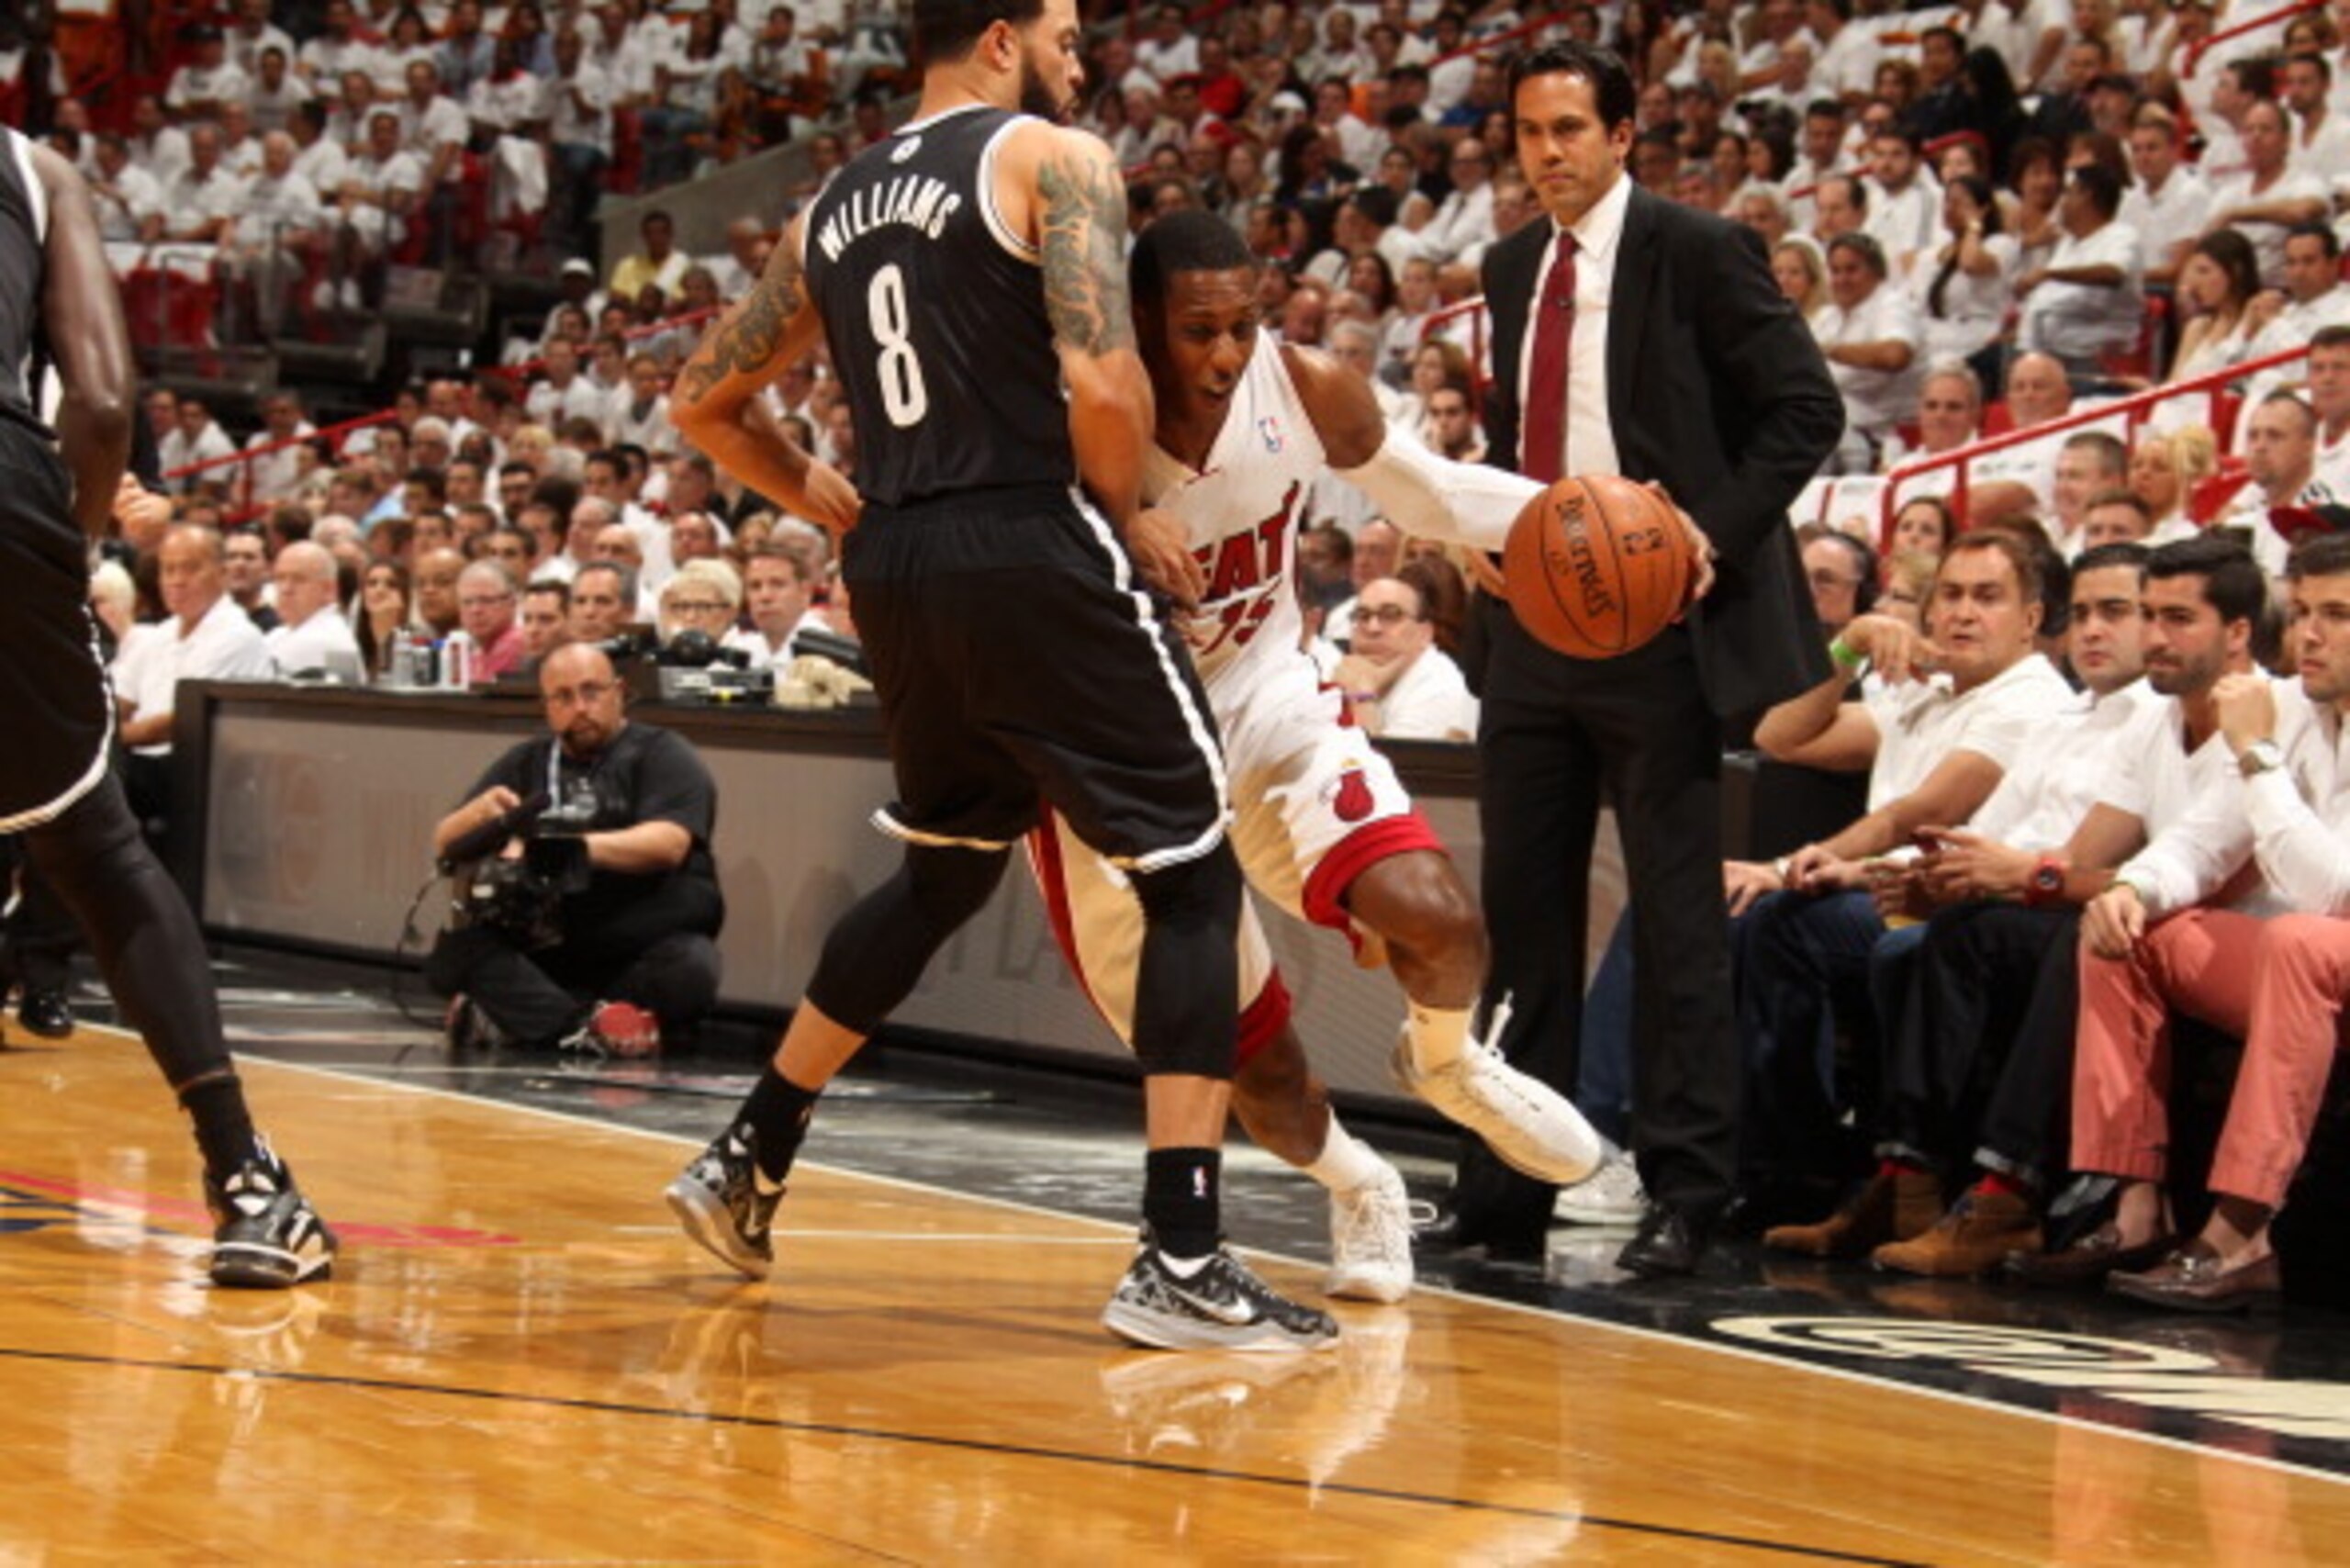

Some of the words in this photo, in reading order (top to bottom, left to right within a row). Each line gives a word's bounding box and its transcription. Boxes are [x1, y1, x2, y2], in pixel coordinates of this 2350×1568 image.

[817, 174, 961, 263] WILLIAMS
[867, 262, 928, 428] 8
[1191, 479, 1301, 606] EAT
